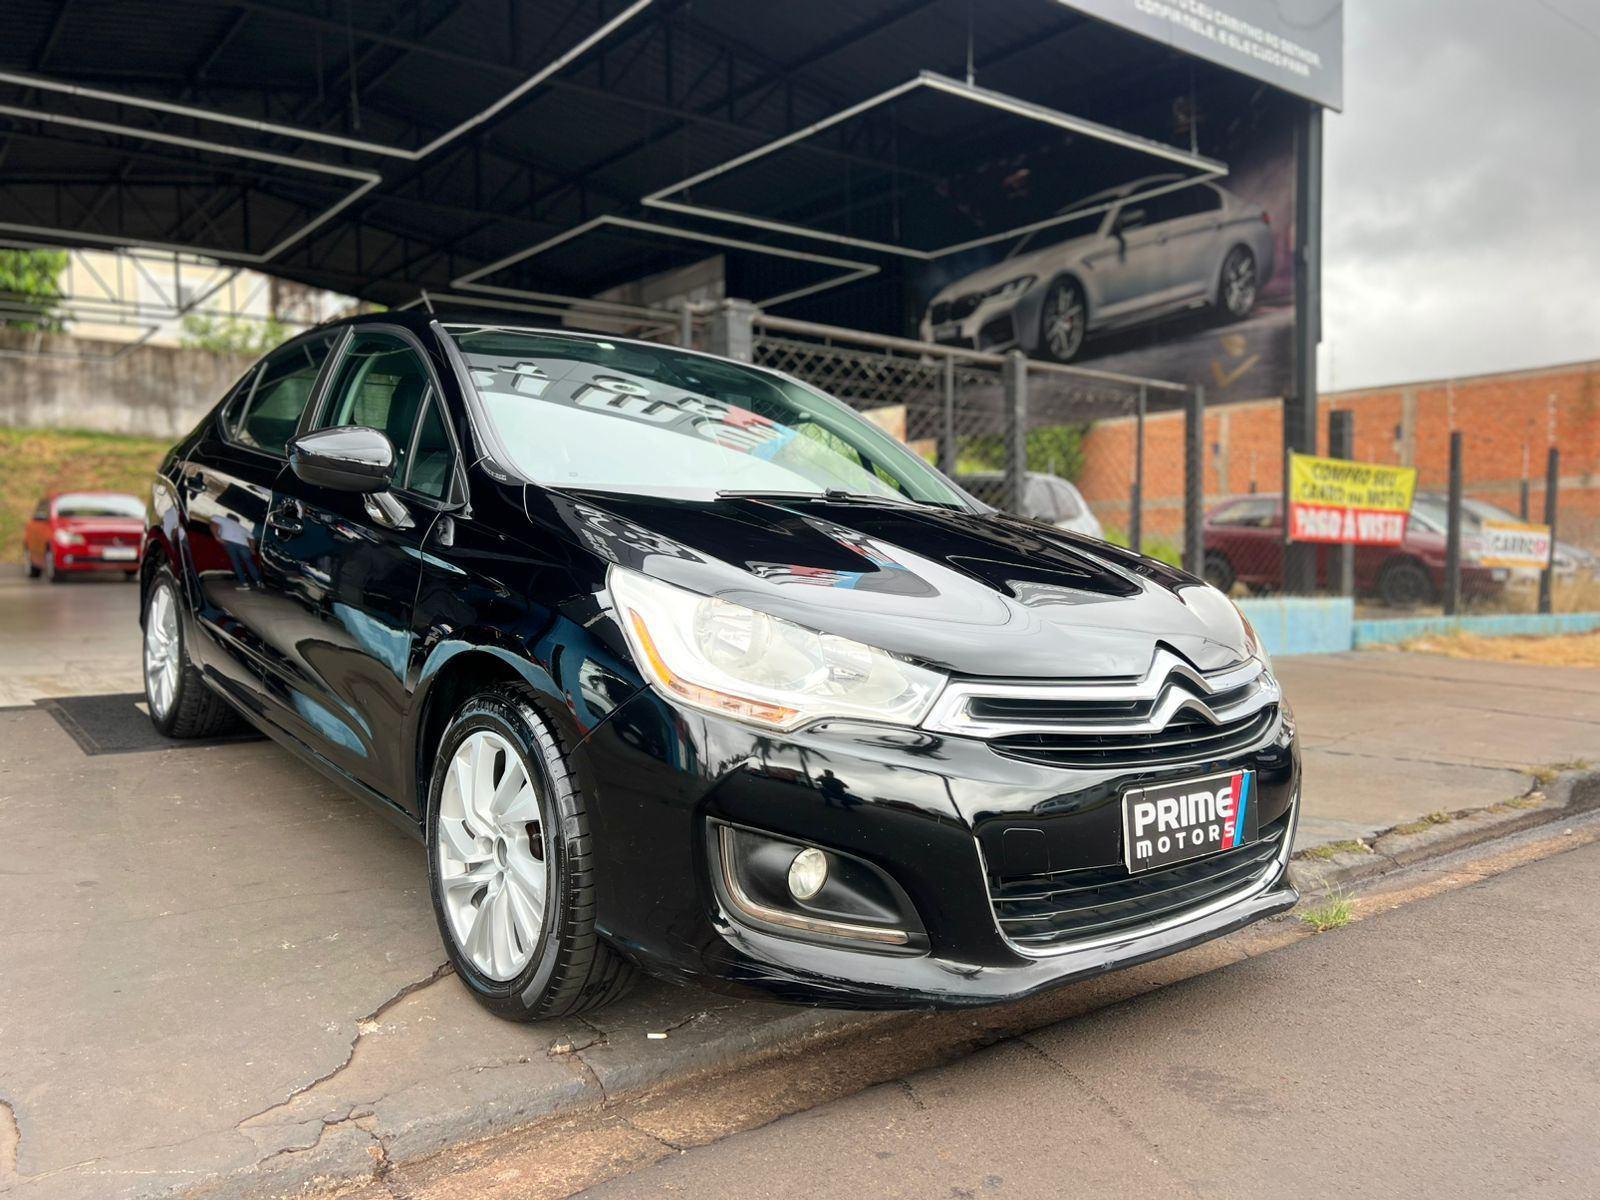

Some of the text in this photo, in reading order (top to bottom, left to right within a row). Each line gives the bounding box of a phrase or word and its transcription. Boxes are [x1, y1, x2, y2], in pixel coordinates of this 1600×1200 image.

[1312, 463, 1372, 485] COMPRO
[1366, 489, 1405, 508] MOTO
[1357, 511, 1403, 543] VISTA
[1134, 786, 1234, 837] PRIME
[1136, 821, 1235, 859] MOTORS
